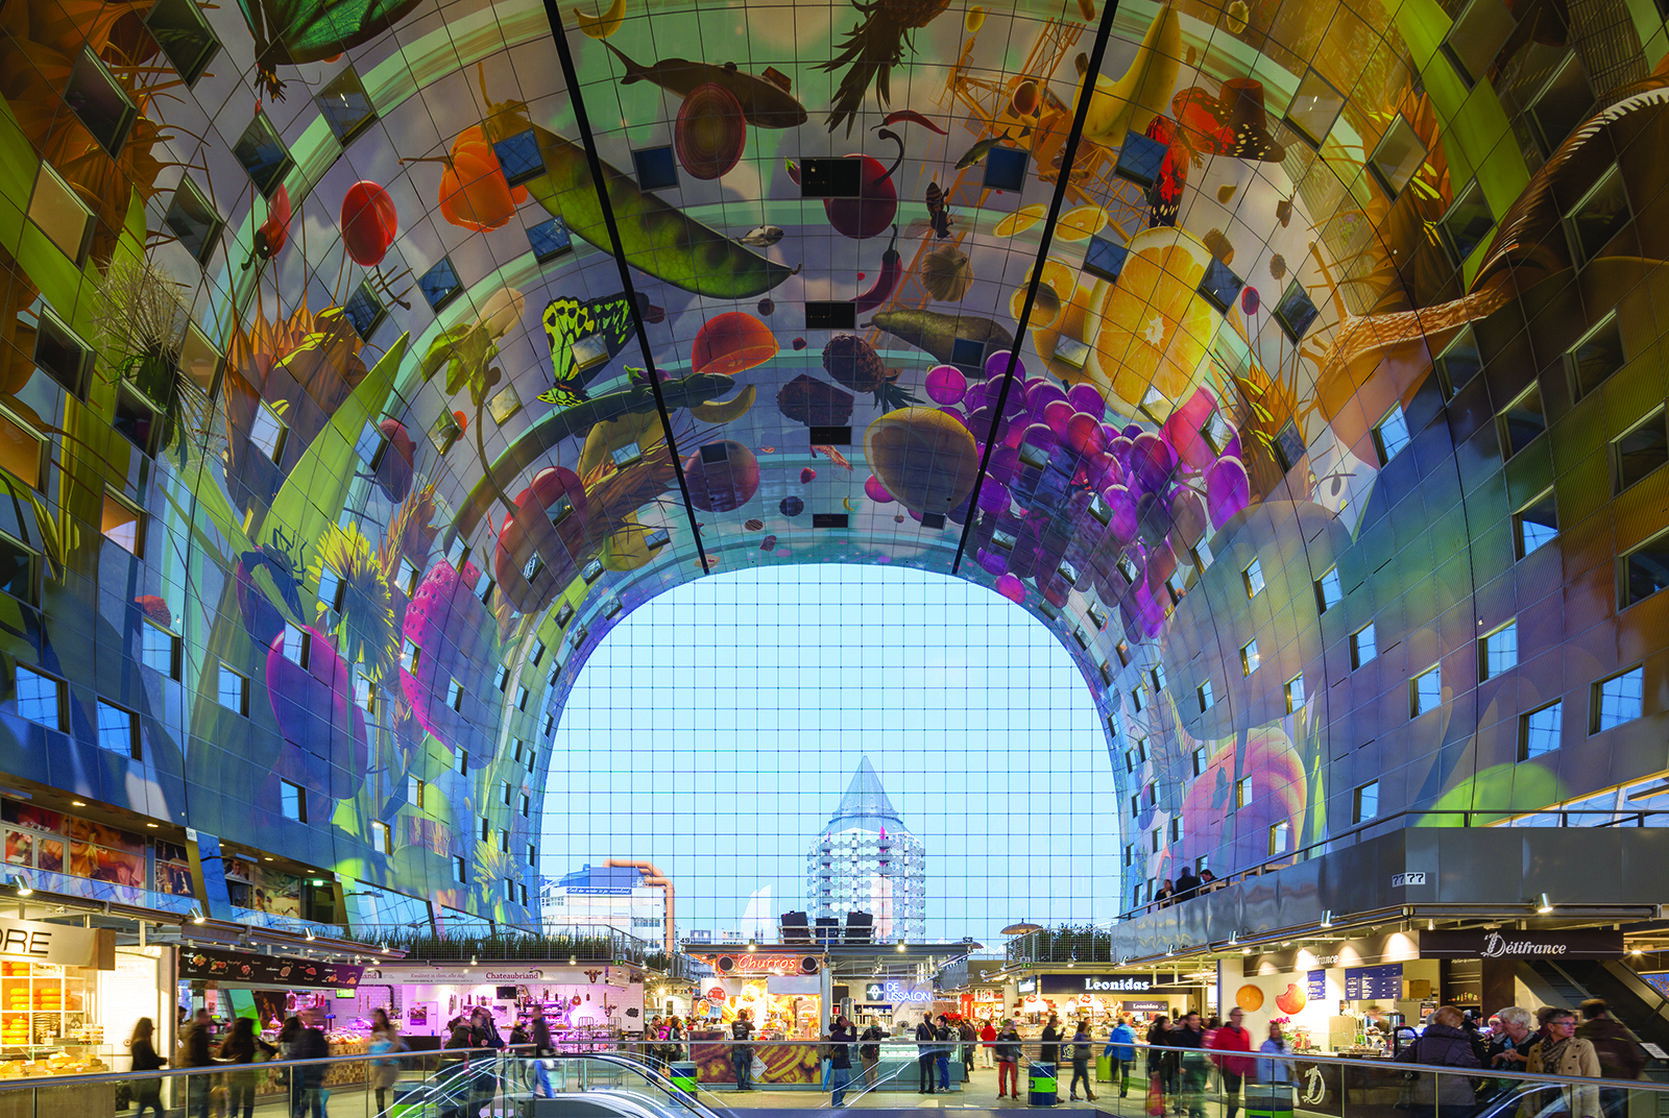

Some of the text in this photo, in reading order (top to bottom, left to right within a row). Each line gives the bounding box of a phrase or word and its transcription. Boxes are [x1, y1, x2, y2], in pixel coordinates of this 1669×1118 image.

[1393, 874, 1405, 885] 77
[1407, 873, 1424, 883] 77
[1480, 931, 1566, 958] Délifrance
[738, 955, 796, 969] Churros
[886, 982, 899, 992] DE
[1085, 978, 1150, 990] Leonidas
